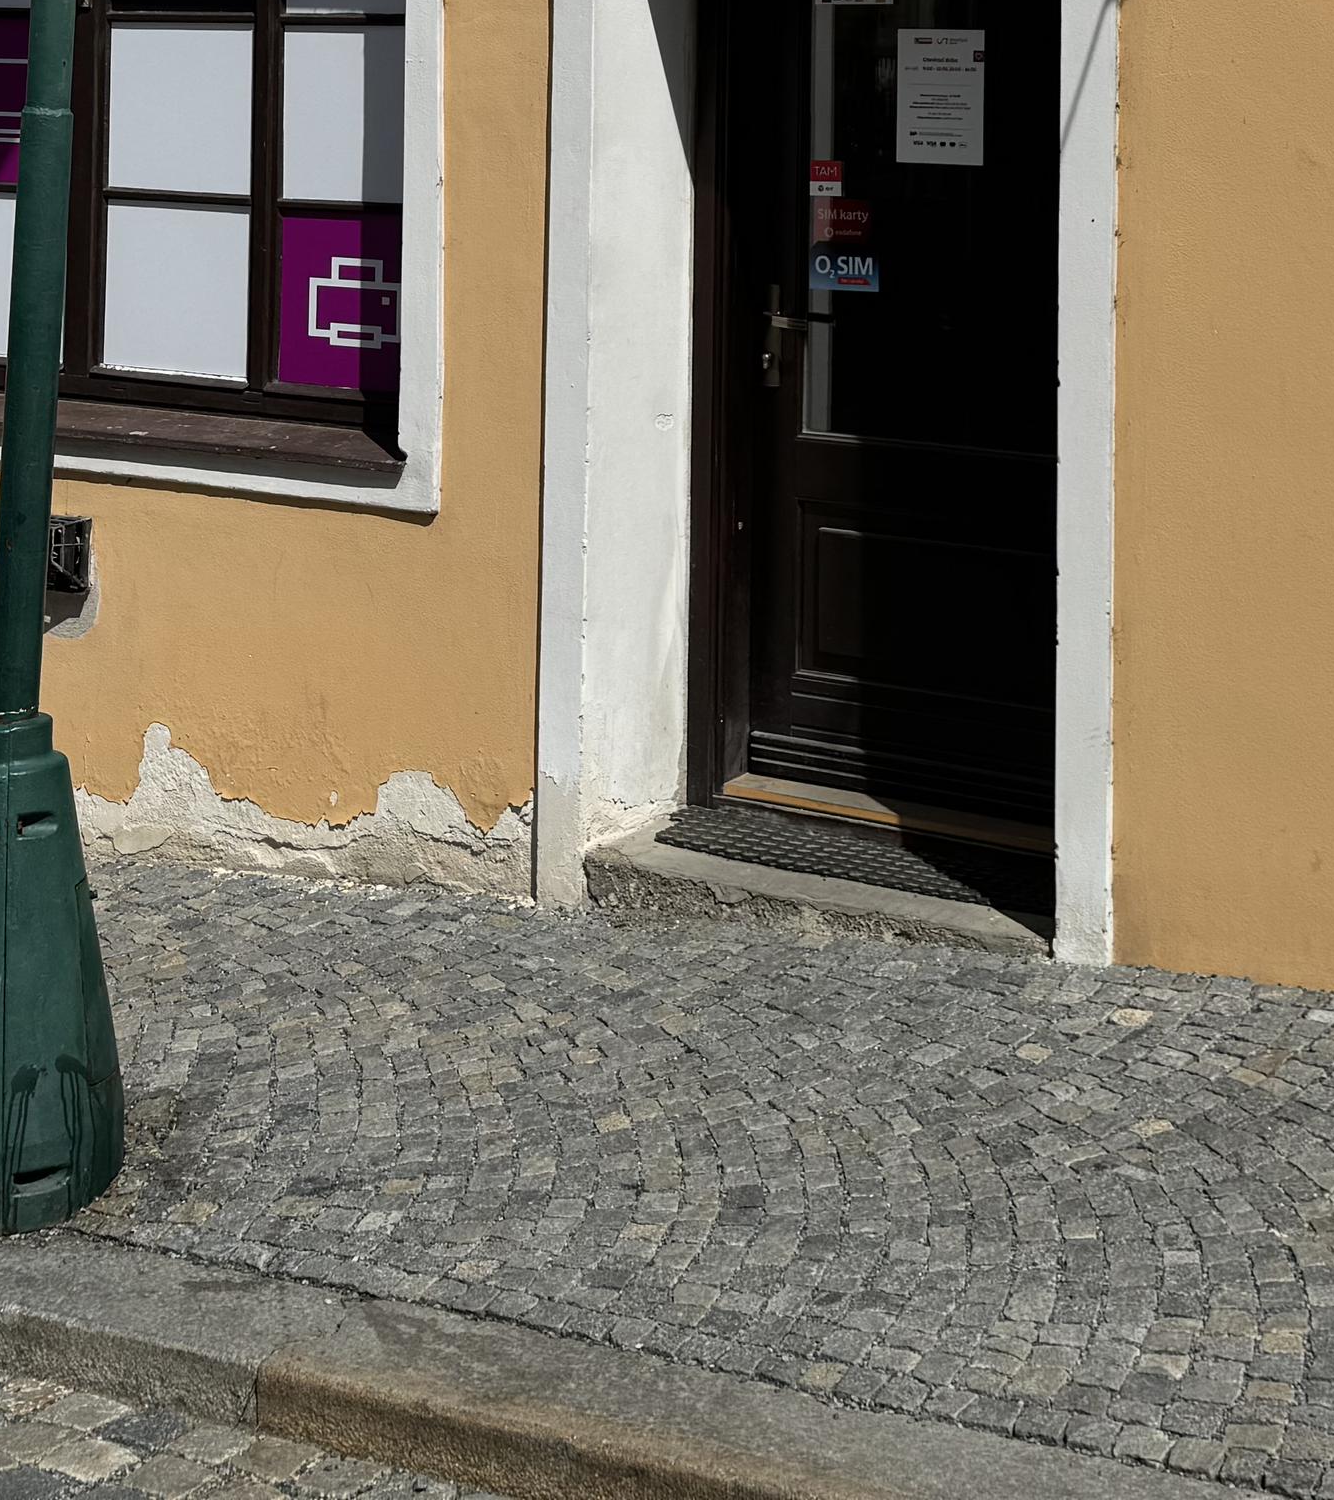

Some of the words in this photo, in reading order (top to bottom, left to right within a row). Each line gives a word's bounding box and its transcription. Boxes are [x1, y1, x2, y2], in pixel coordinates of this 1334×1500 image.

[817, 208, 837, 220] SIM
[839, 208, 869, 224] karty
[837, 256, 873, 276] SIM
